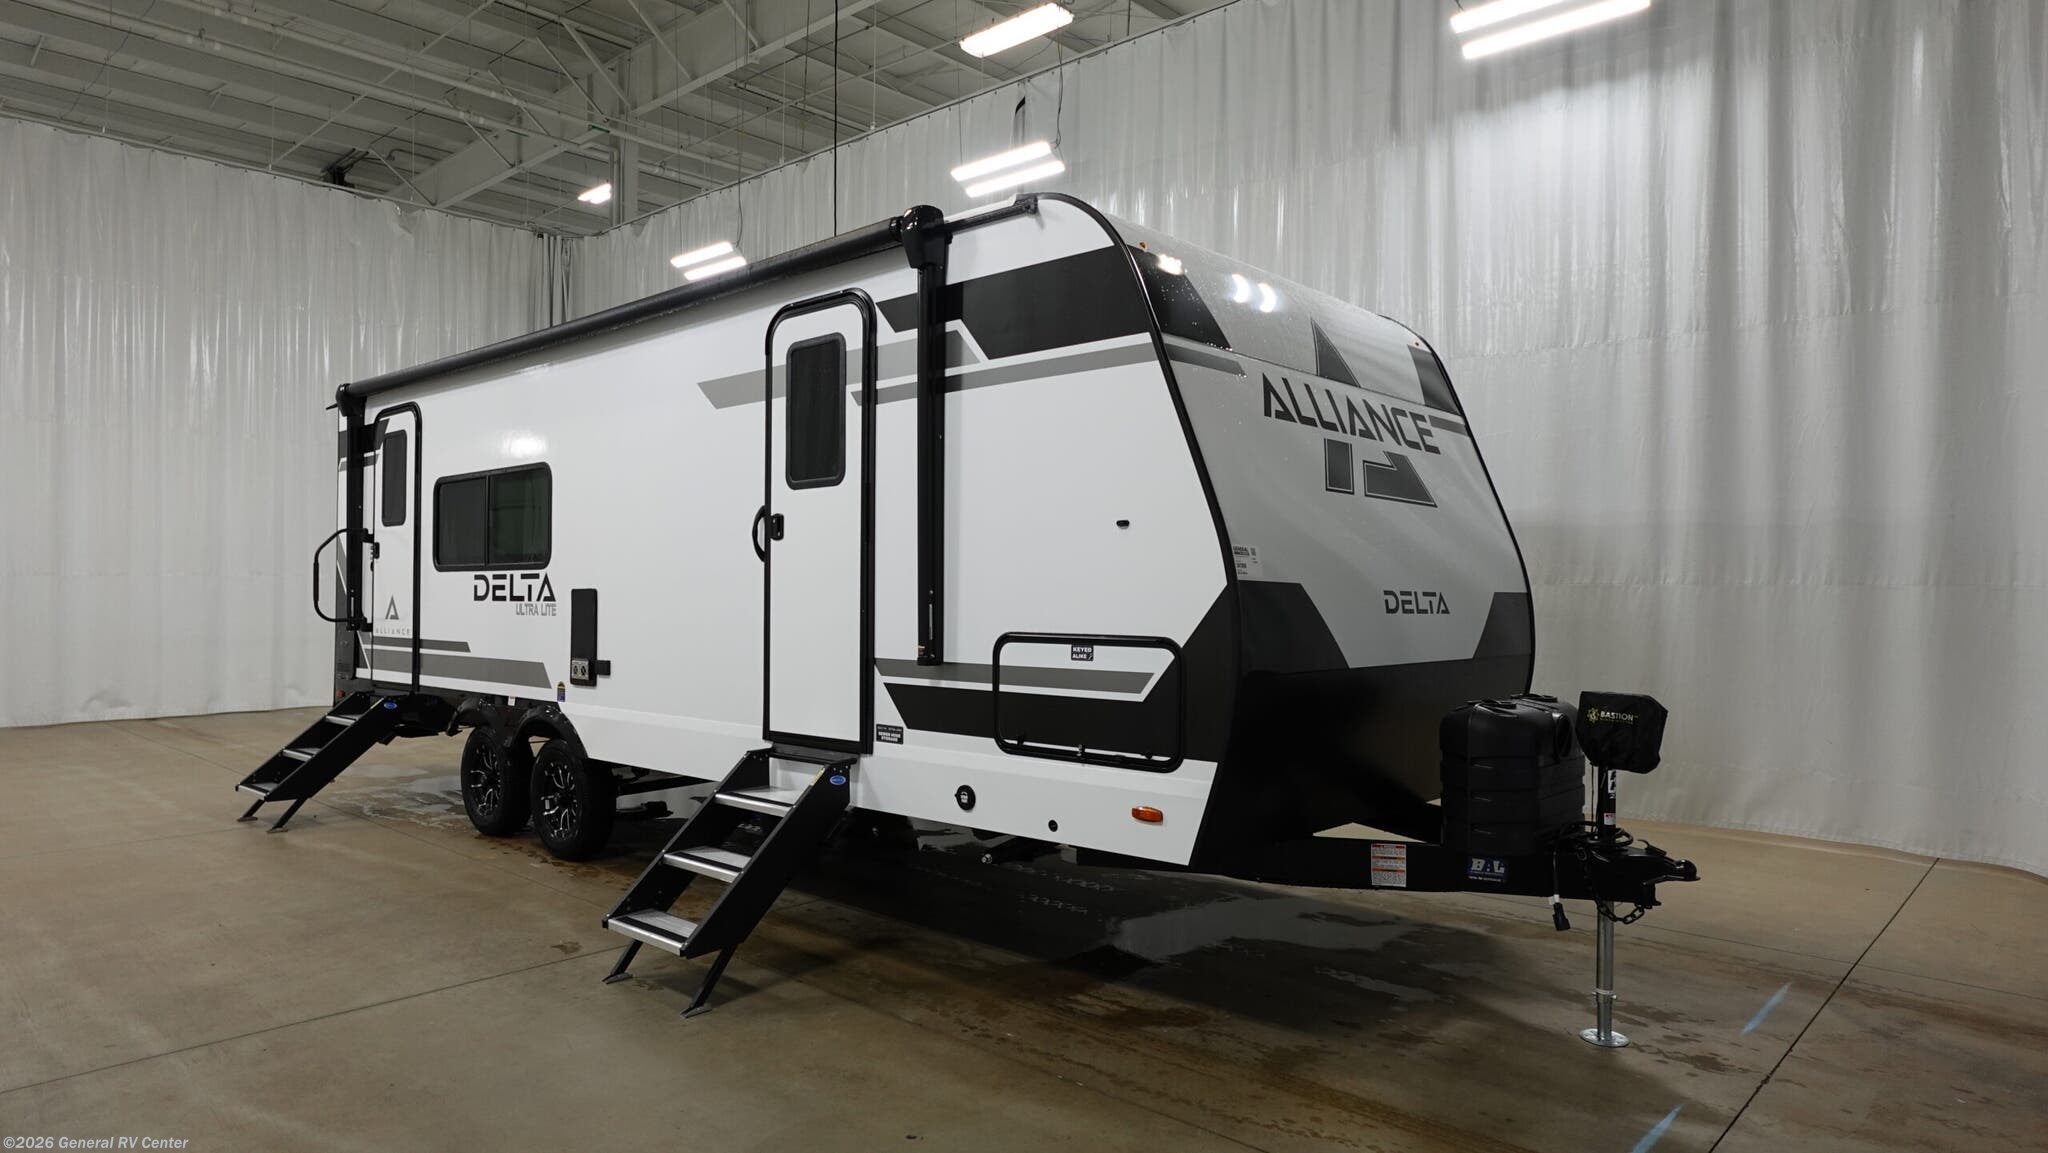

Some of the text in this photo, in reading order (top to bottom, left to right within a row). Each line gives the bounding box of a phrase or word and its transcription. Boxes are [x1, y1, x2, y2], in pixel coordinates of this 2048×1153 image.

[1262, 373, 1441, 455] ALLIANCE
[473, 572, 556, 601] DELTA
[515, 603, 557, 616] ULTRA LITE
[1383, 589, 1450, 615] DELTA
[375, 627, 411, 636] ALLIANCE
[1600, 710, 1634, 721] BASTION
